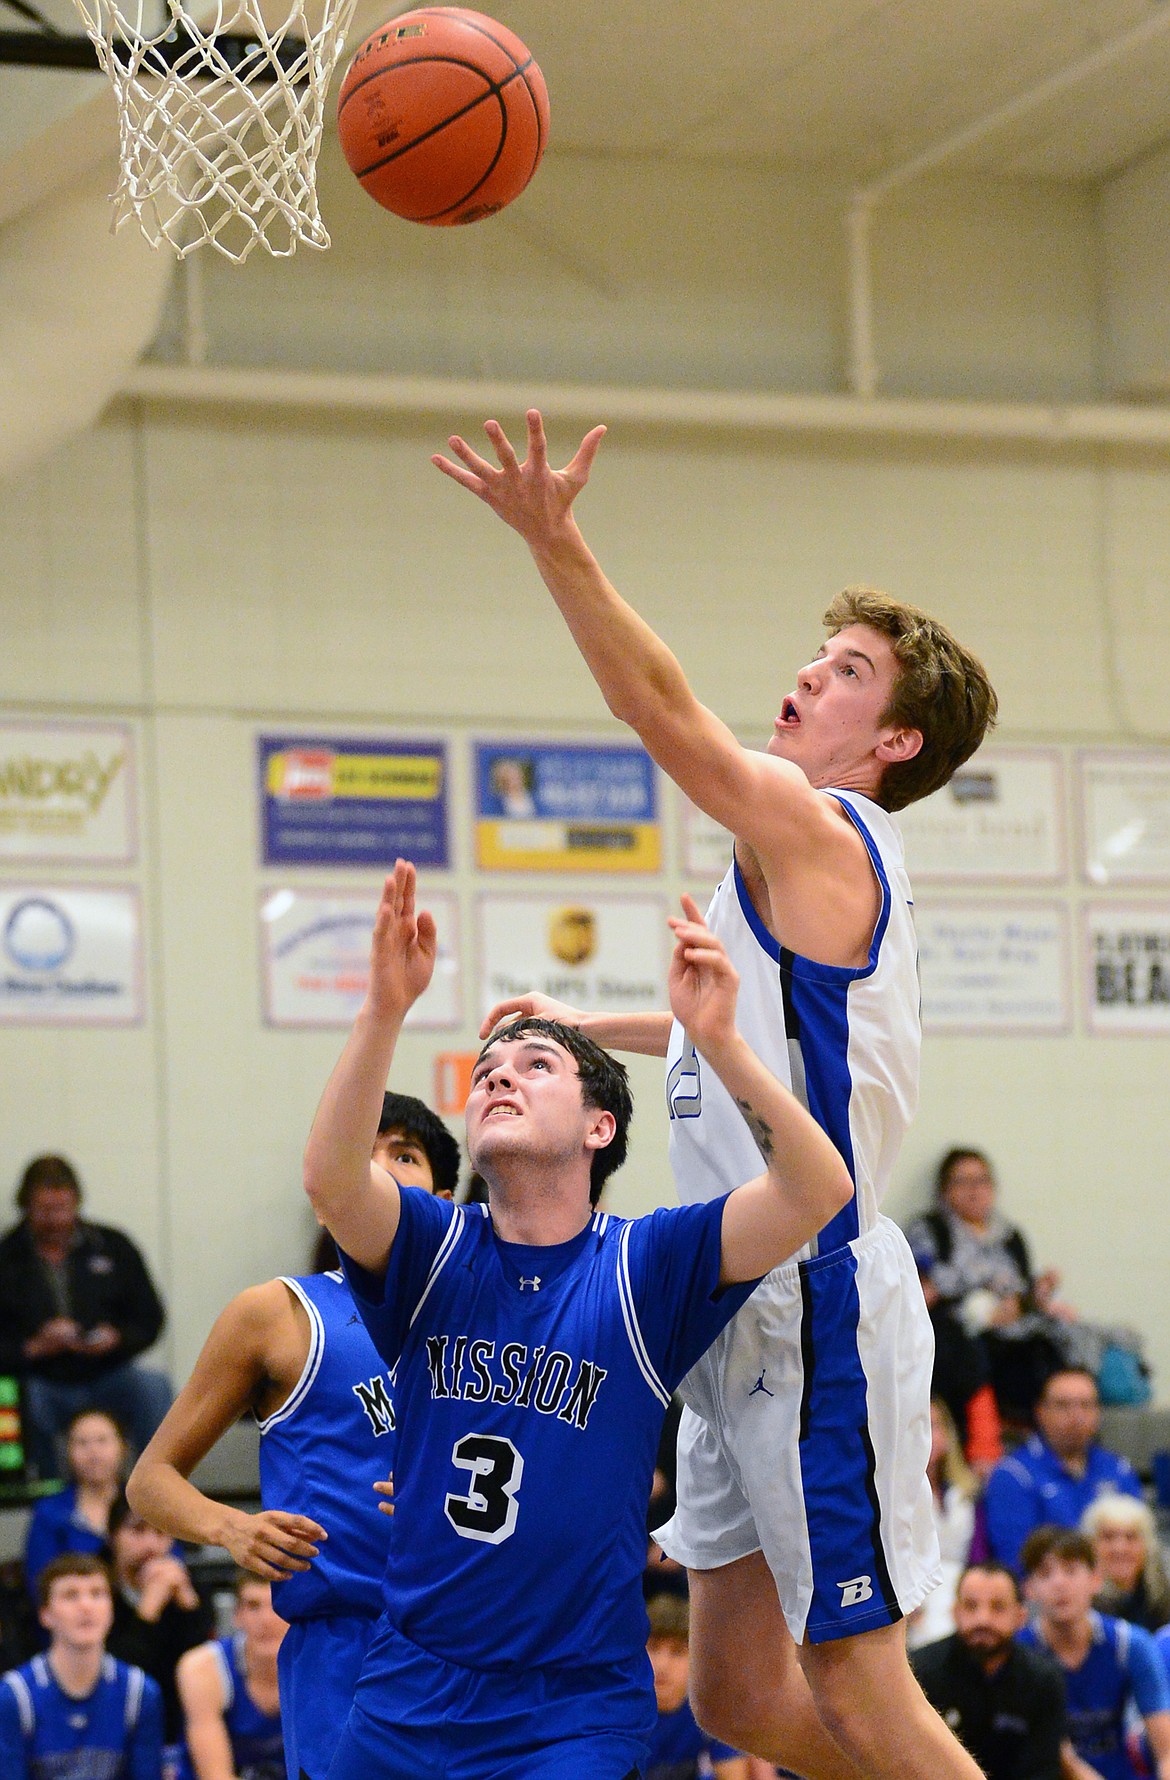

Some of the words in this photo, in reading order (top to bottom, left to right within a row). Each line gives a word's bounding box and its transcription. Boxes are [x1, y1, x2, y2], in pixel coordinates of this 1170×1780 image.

[426, 1335, 608, 1431] MISSION
[443, 1432, 525, 1545] 3
[836, 1575, 873, 1608] B
